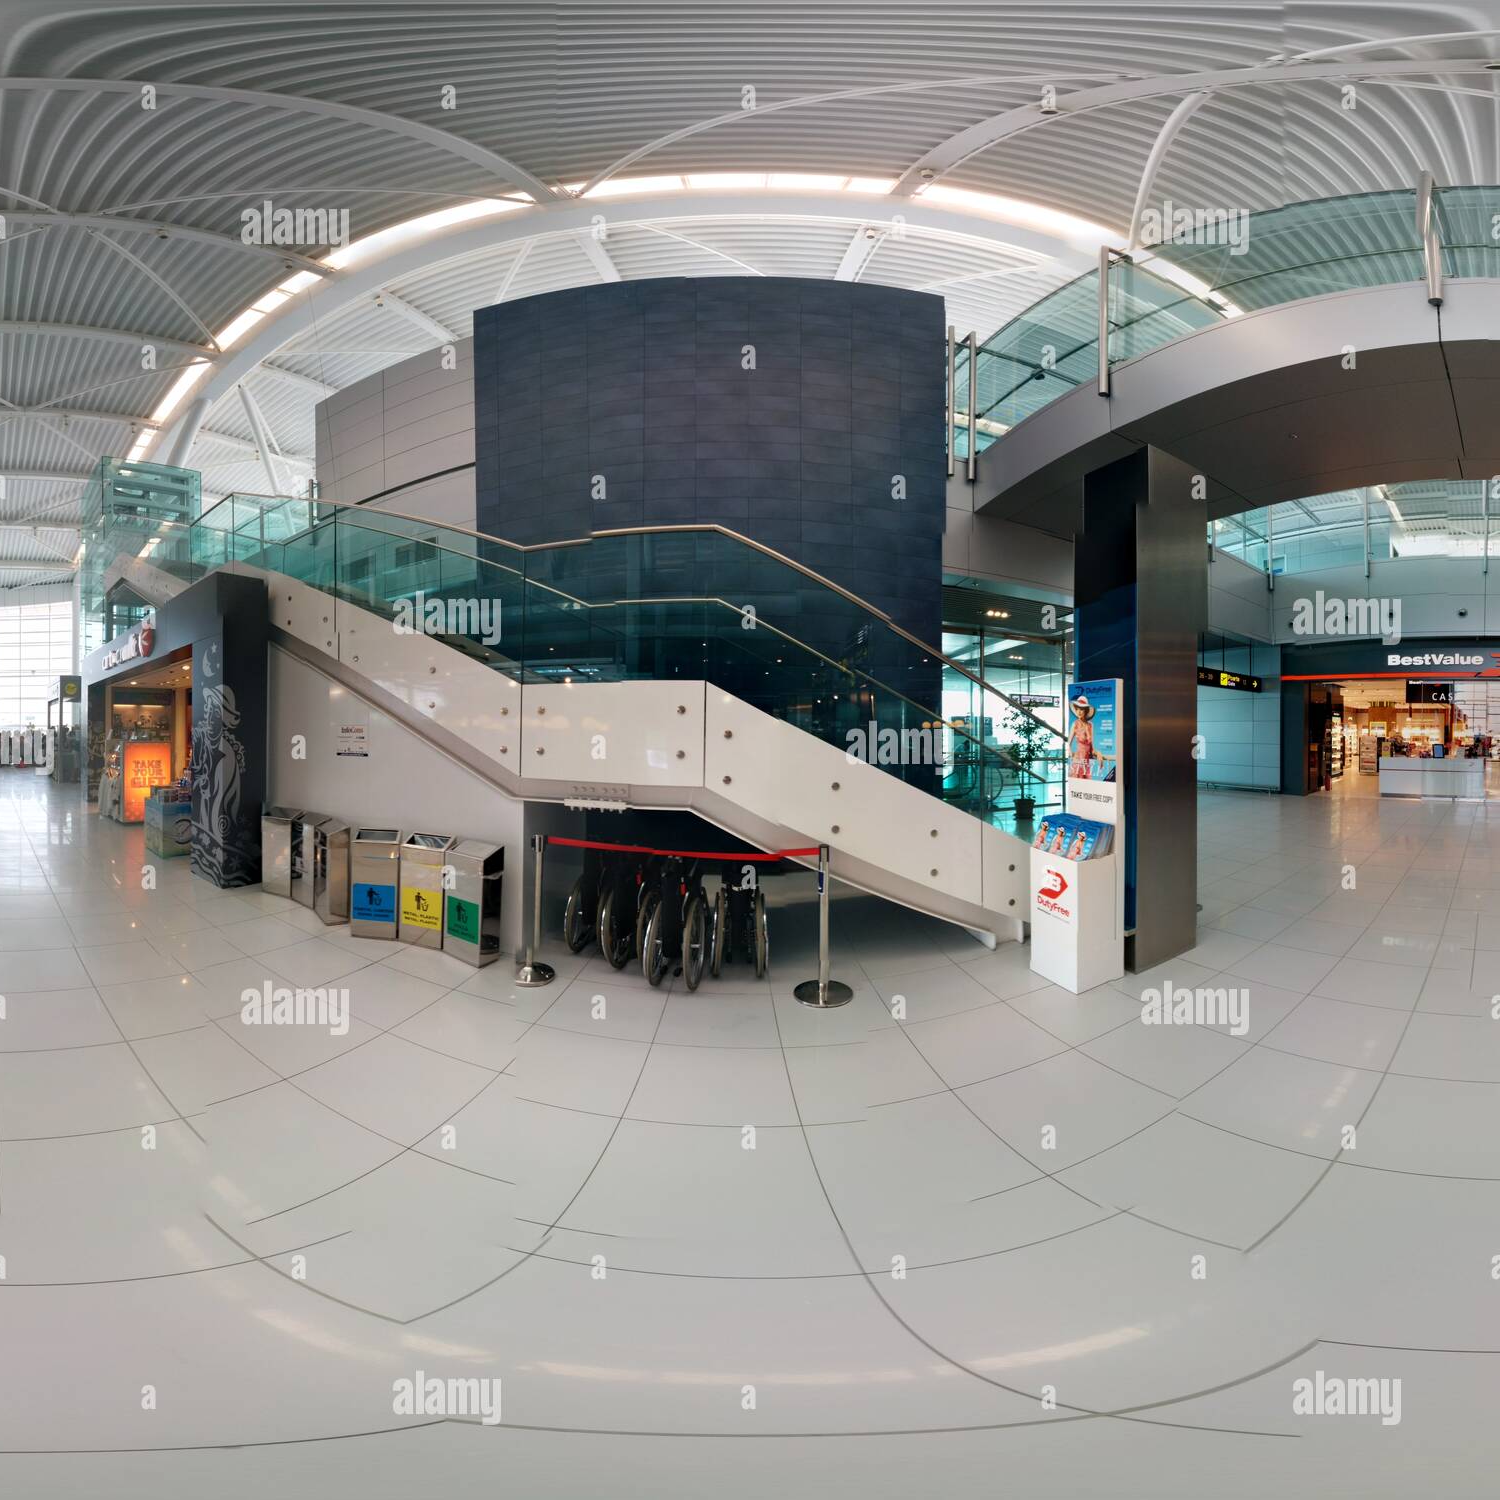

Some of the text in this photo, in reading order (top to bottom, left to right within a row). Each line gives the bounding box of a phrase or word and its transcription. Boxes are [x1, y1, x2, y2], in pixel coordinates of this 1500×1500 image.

[1387, 653, 1484, 666] BestValue
[132, 760, 162, 768] TAKE
[132, 768, 164, 776] YOUR
[131, 776, 166, 788] GIFT
[1070, 790, 1082, 800] TAKE
[1037, 895, 1070, 918] DutyFree
